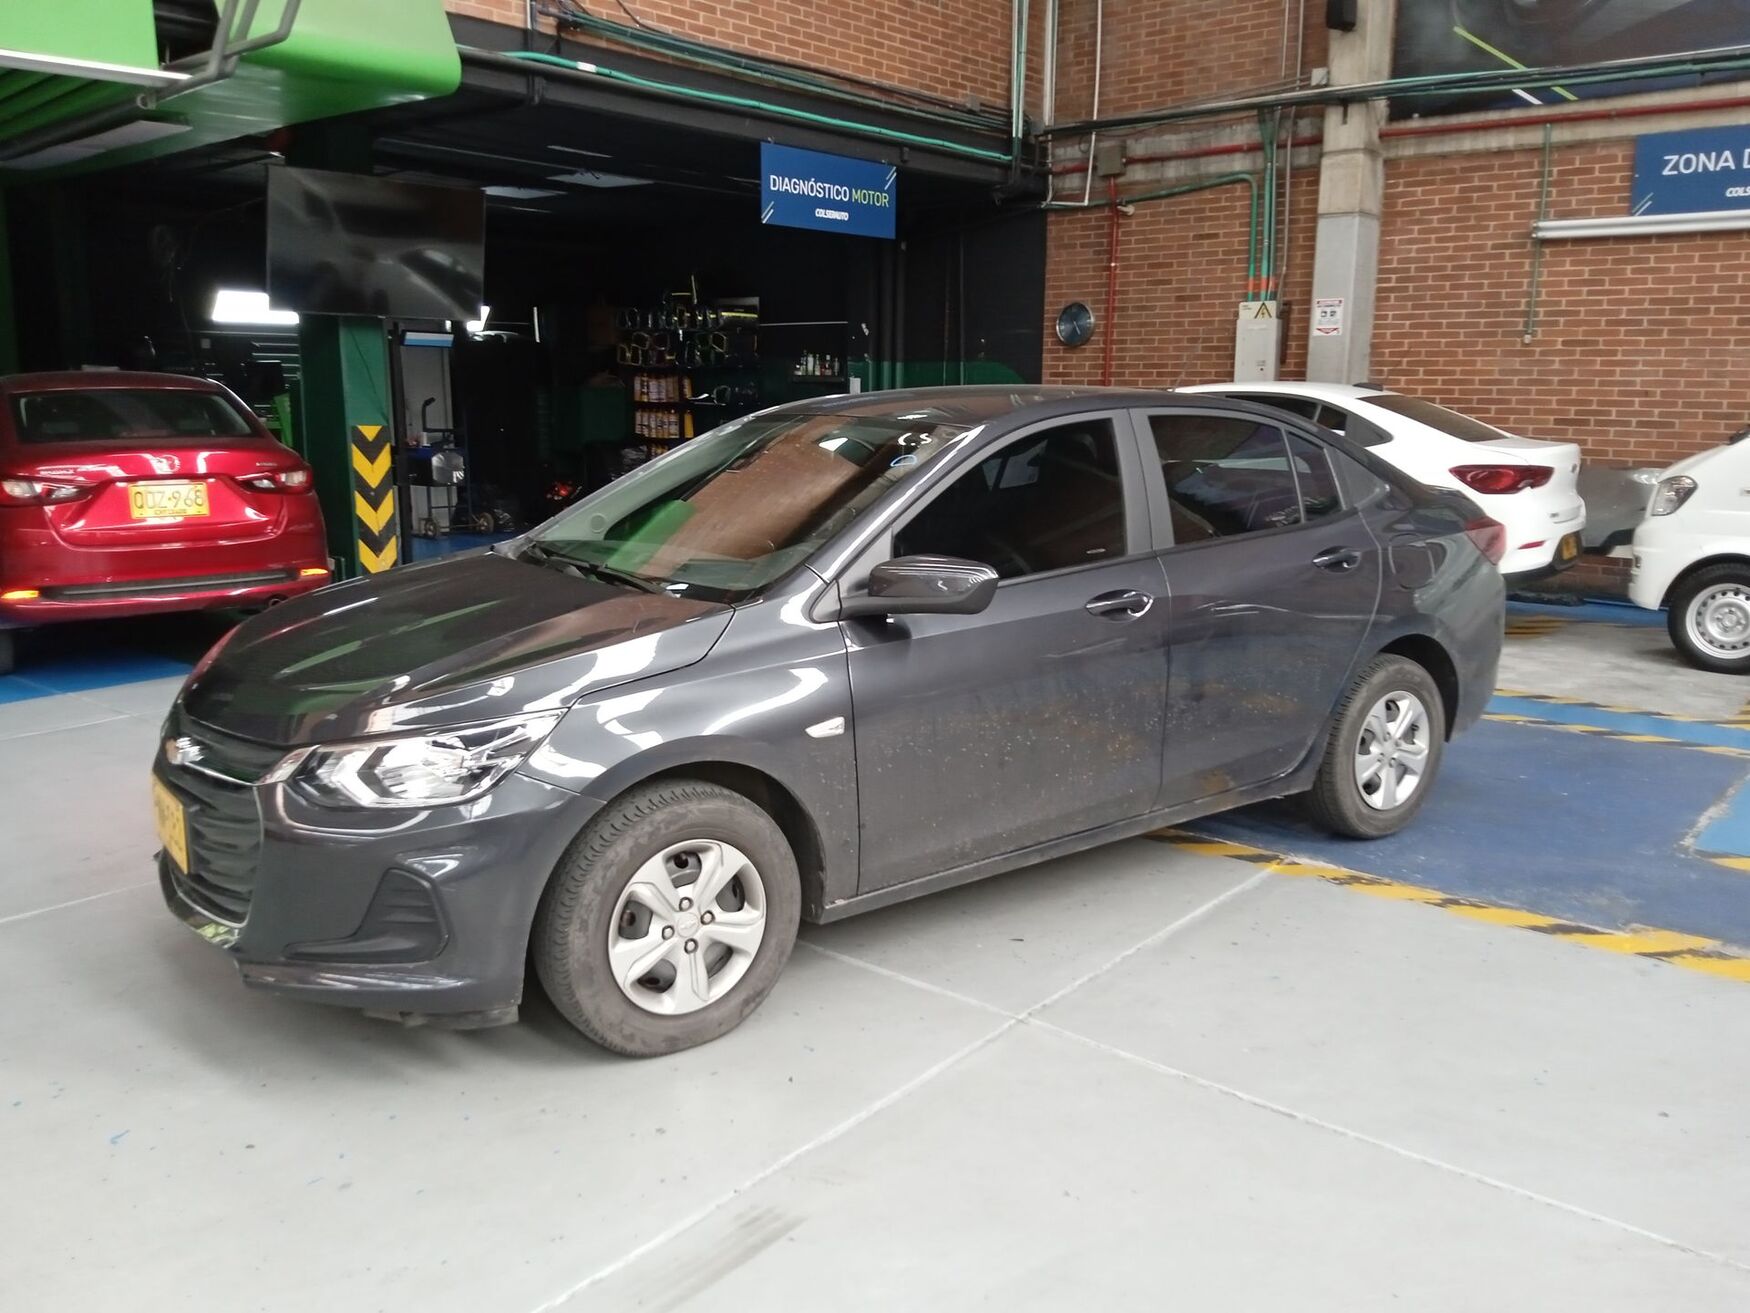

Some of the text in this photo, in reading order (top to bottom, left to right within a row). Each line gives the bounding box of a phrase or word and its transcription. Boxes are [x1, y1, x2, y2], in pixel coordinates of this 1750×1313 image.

[1662, 150, 1735, 175] ZONA
[769, 175, 889, 207] DIAGNÓSTICO MOTOR
